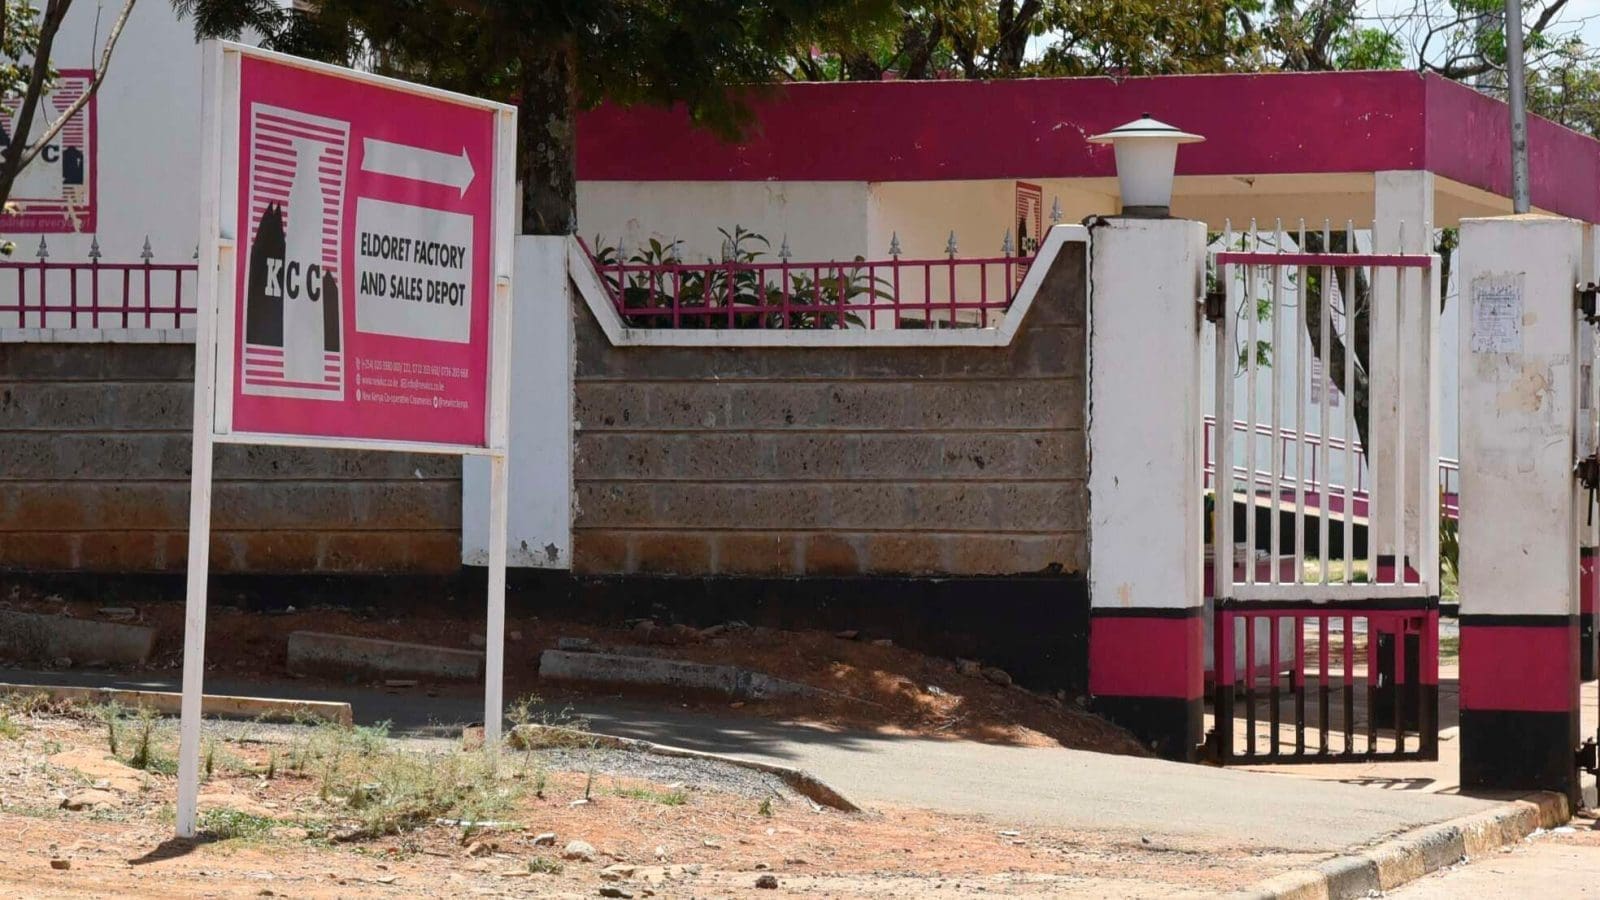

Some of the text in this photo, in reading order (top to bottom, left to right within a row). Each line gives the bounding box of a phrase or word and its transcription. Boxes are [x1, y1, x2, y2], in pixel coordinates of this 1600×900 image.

[360, 232, 466, 269] ELDORET FACTORY
[264, 257, 321, 302] KCC
[360, 271, 466, 307] AND SALES DEPOT
